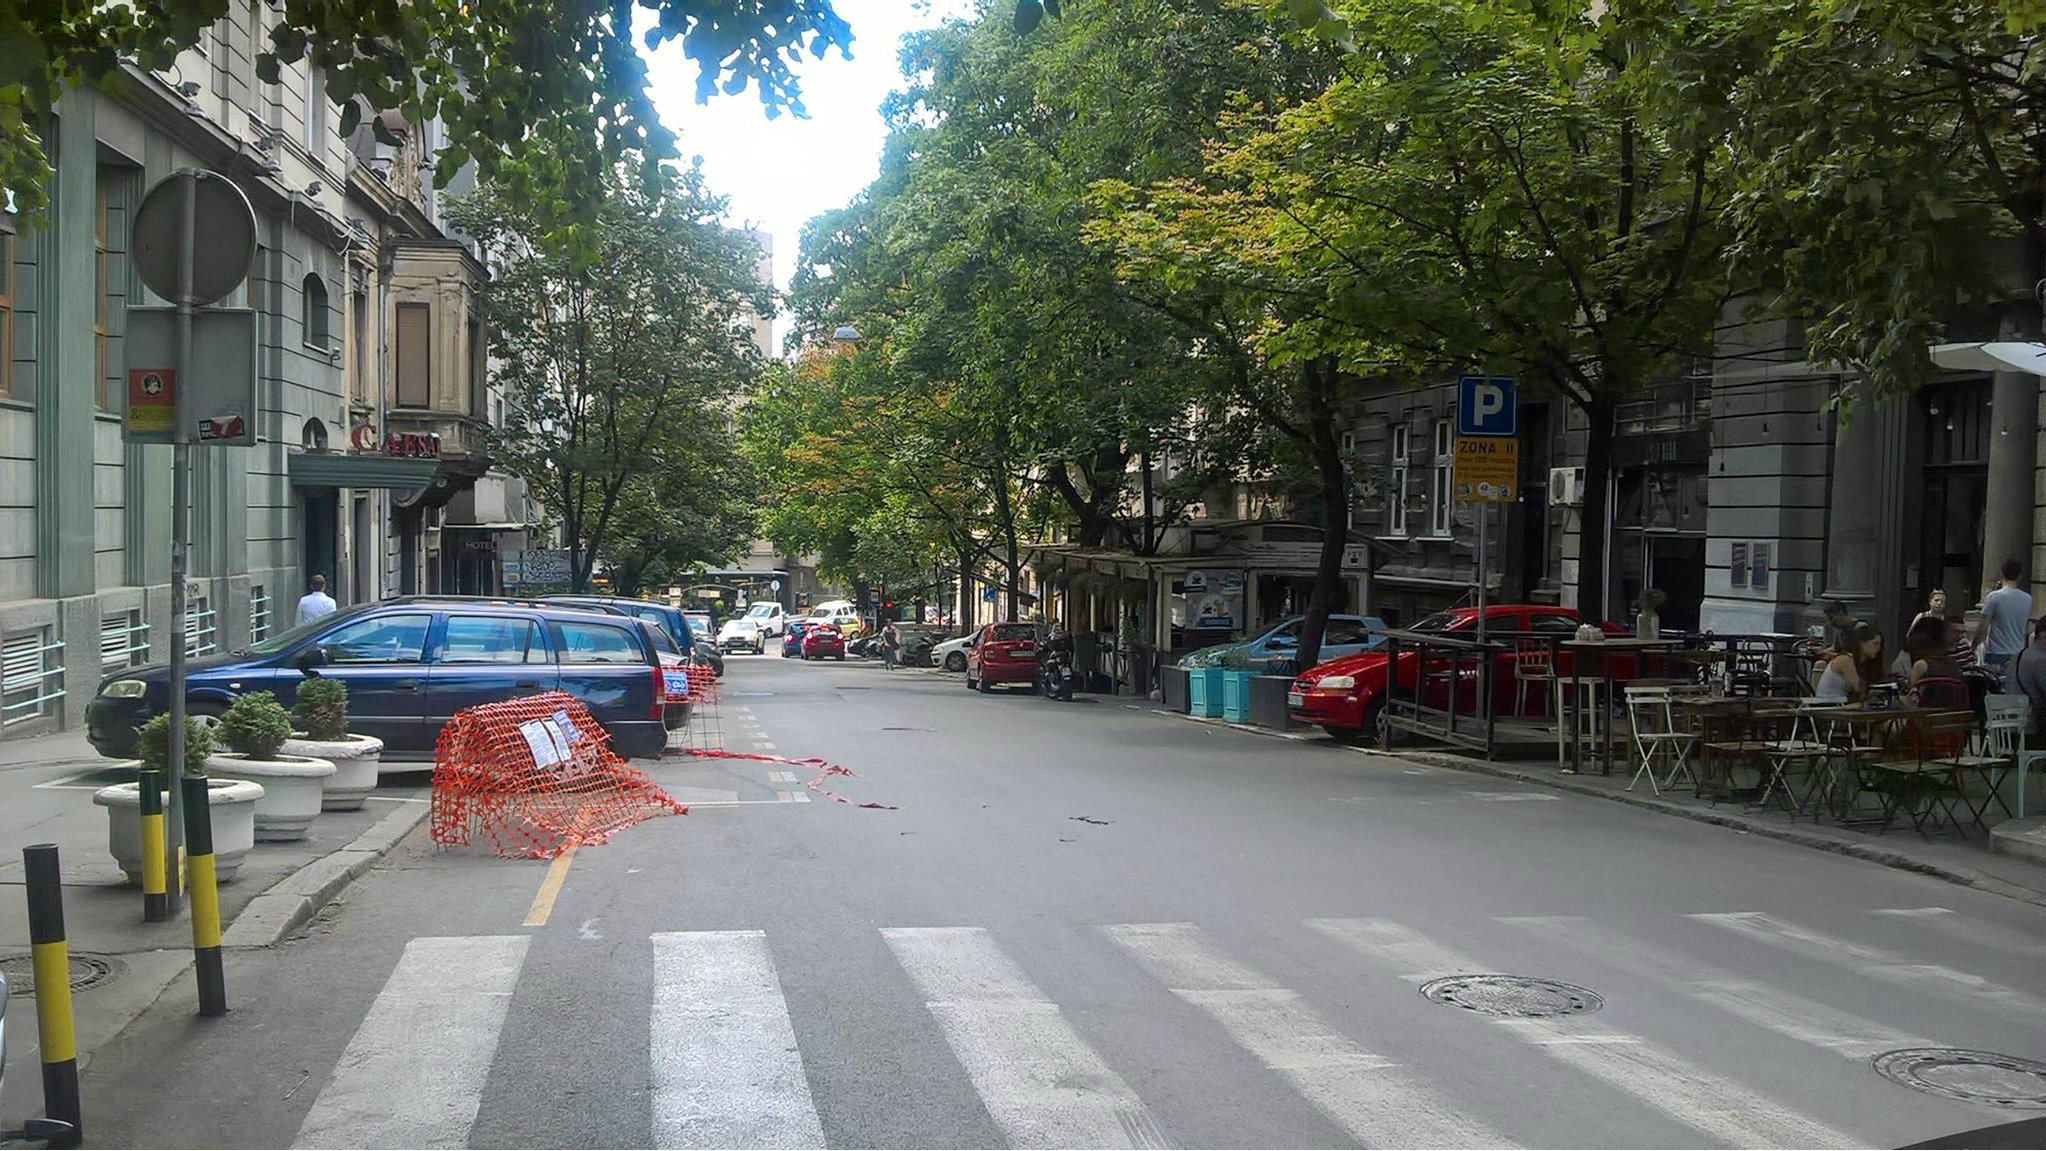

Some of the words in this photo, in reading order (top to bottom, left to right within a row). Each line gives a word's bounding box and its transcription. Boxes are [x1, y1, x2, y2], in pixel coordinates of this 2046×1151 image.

[1474, 384, 1503, 426] P
[1460, 440, 1496, 454] ZONA
[466, 541, 497, 552] HOTEL
